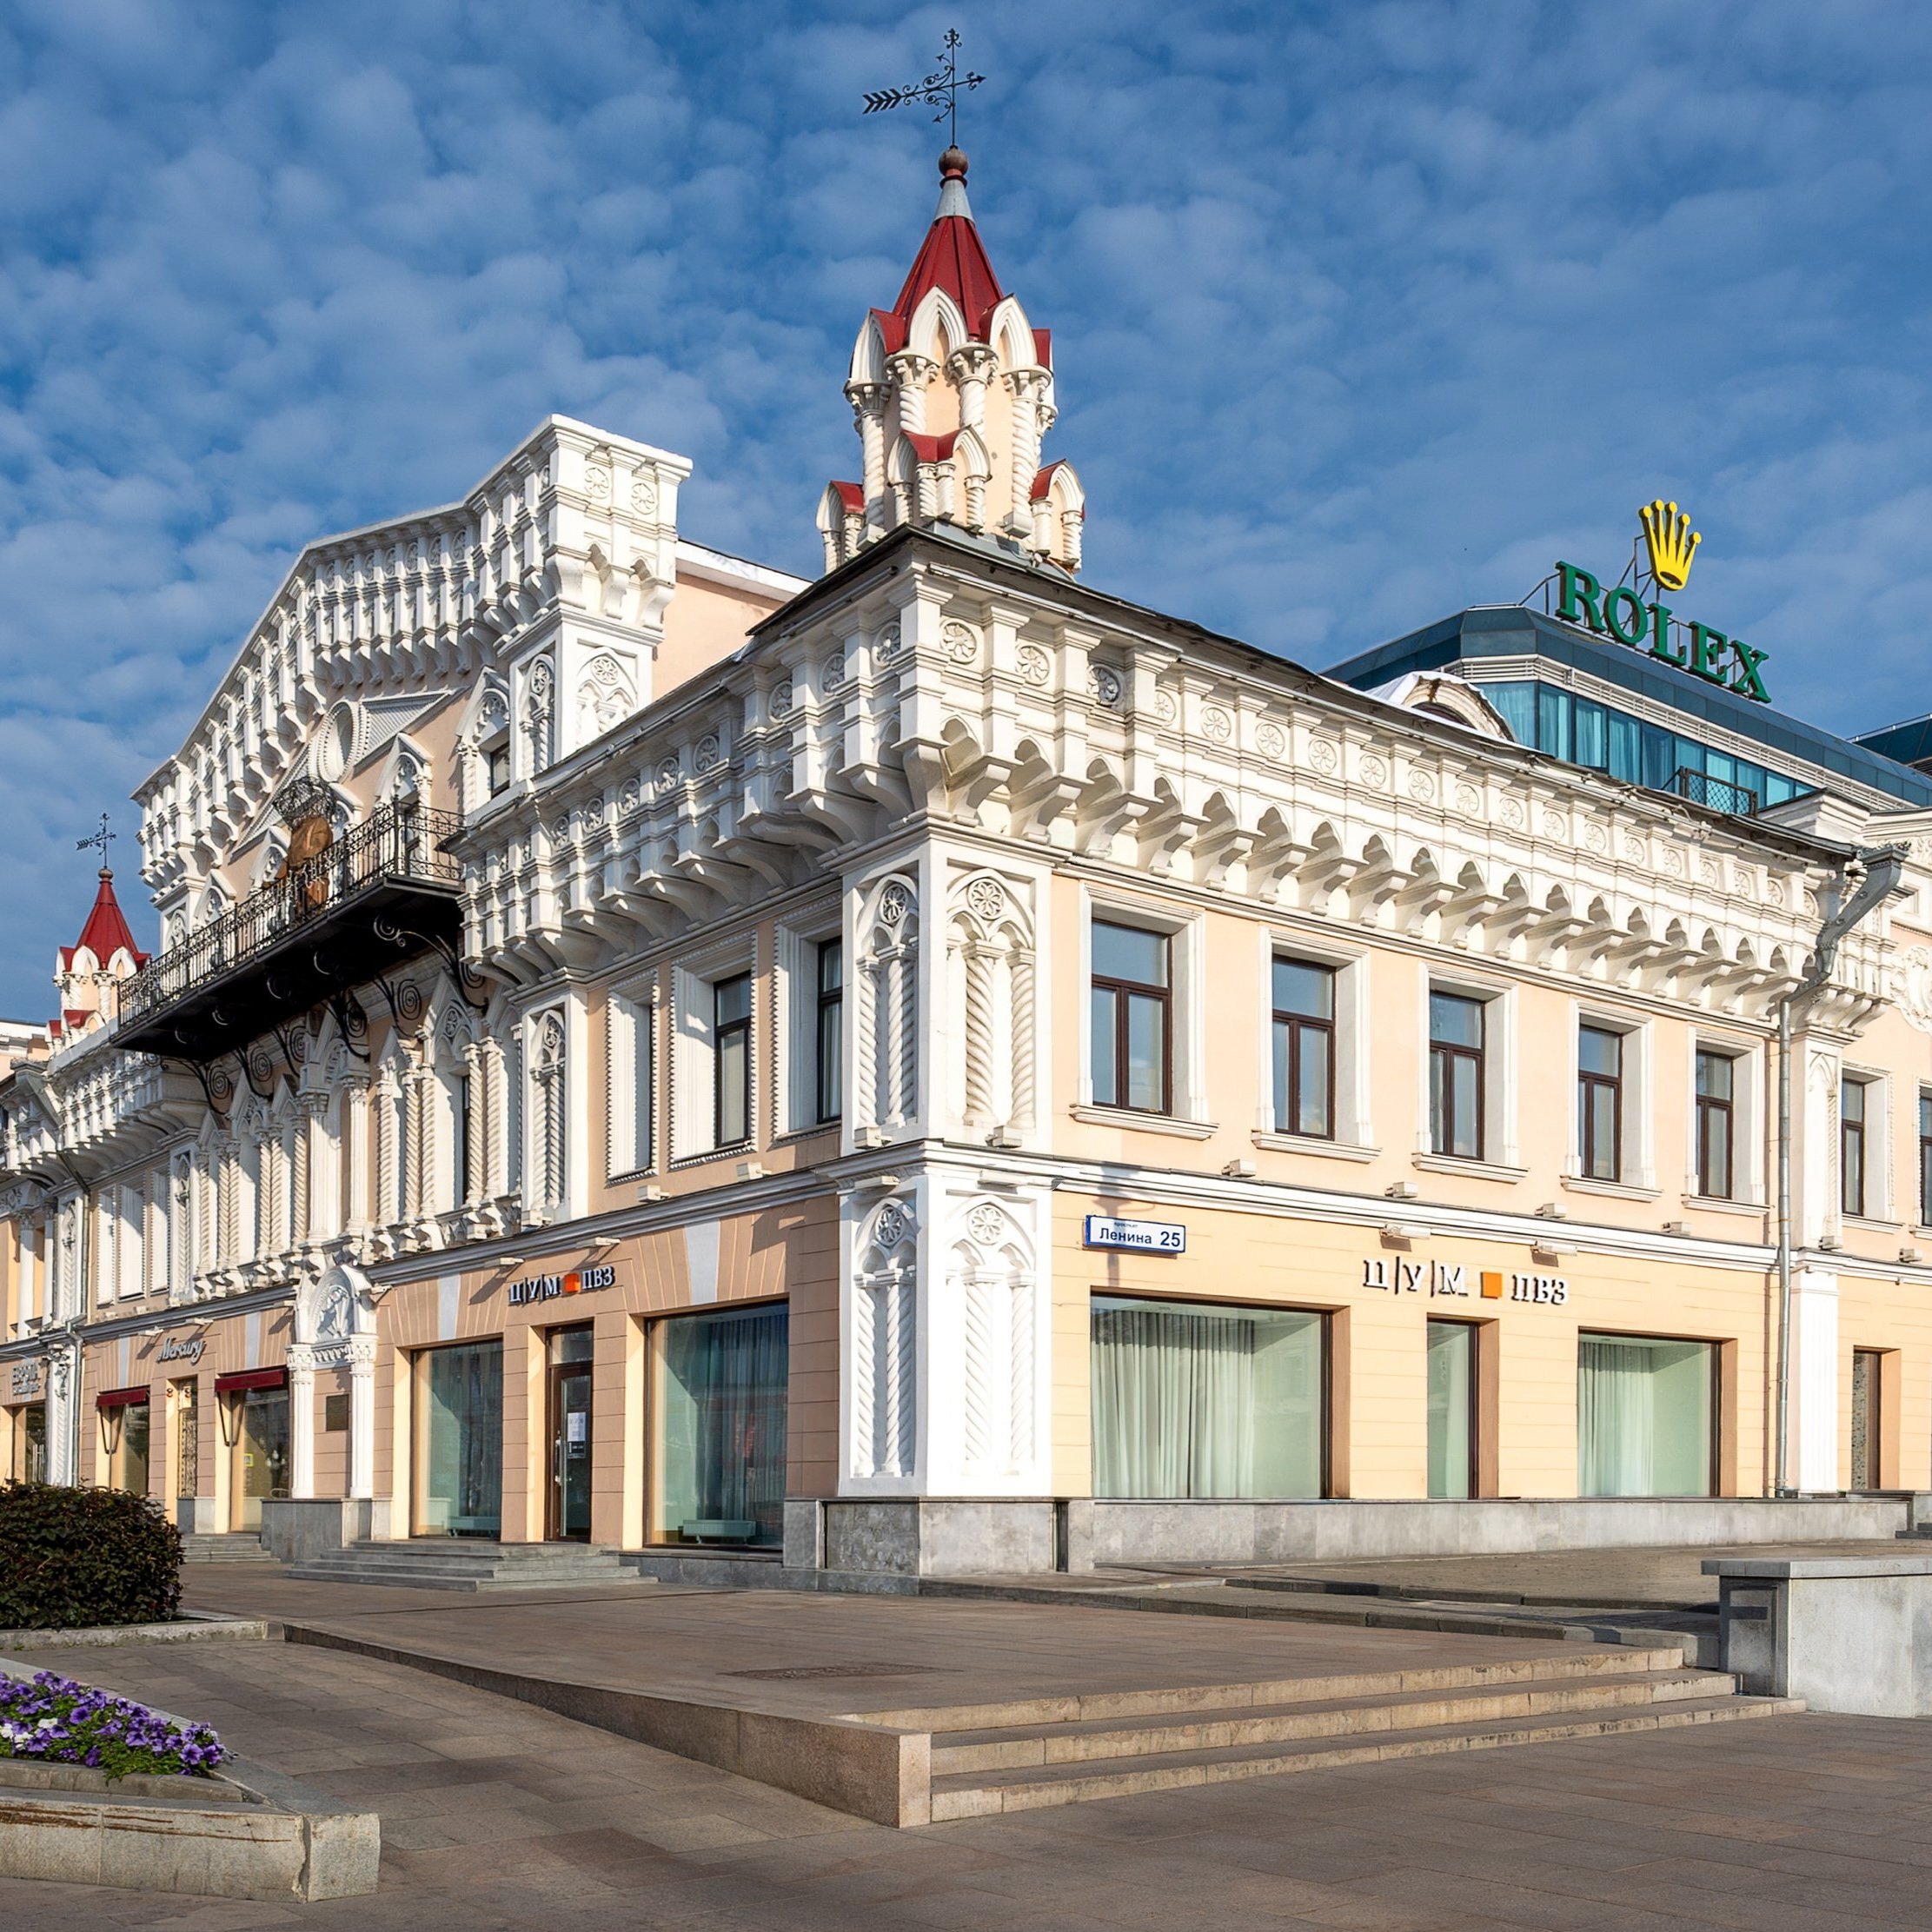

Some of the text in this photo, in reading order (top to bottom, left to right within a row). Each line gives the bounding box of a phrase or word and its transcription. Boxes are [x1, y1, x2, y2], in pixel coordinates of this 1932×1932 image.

[1555, 561, 1772, 703] ROLEX
[1099, 1227, 1181, 1247] Ленина 25
[581, 1265, 614, 1291] ПВЗ
[1511, 1274, 1570, 1305] ПВЗ
[156, 1337, 206, 1365] Mercury
